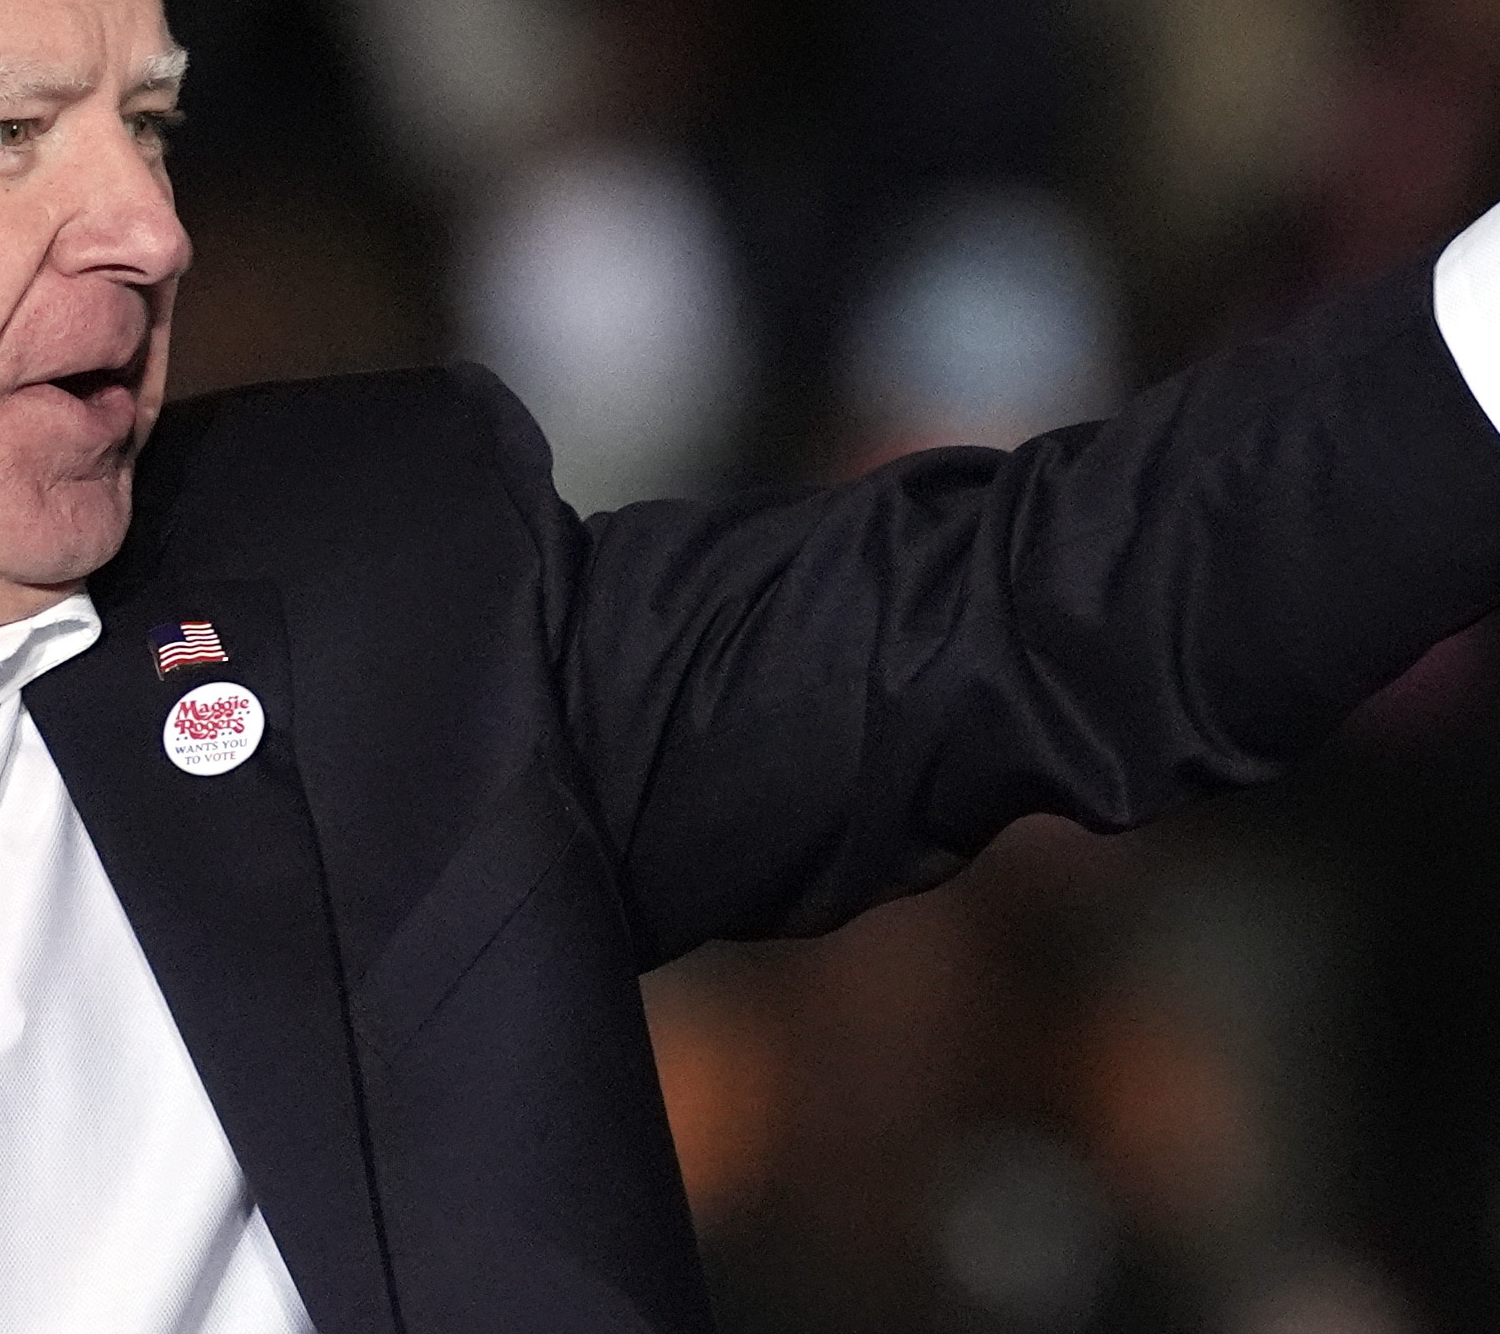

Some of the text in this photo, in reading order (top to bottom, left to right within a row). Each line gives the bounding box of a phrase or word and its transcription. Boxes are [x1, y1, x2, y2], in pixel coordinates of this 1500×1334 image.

[176, 695, 249, 720] Maggie
[174, 717, 245, 740] Rogers
[175, 739, 248, 754] WANTS YOU
[185, 751, 237, 765] TO VOTE
